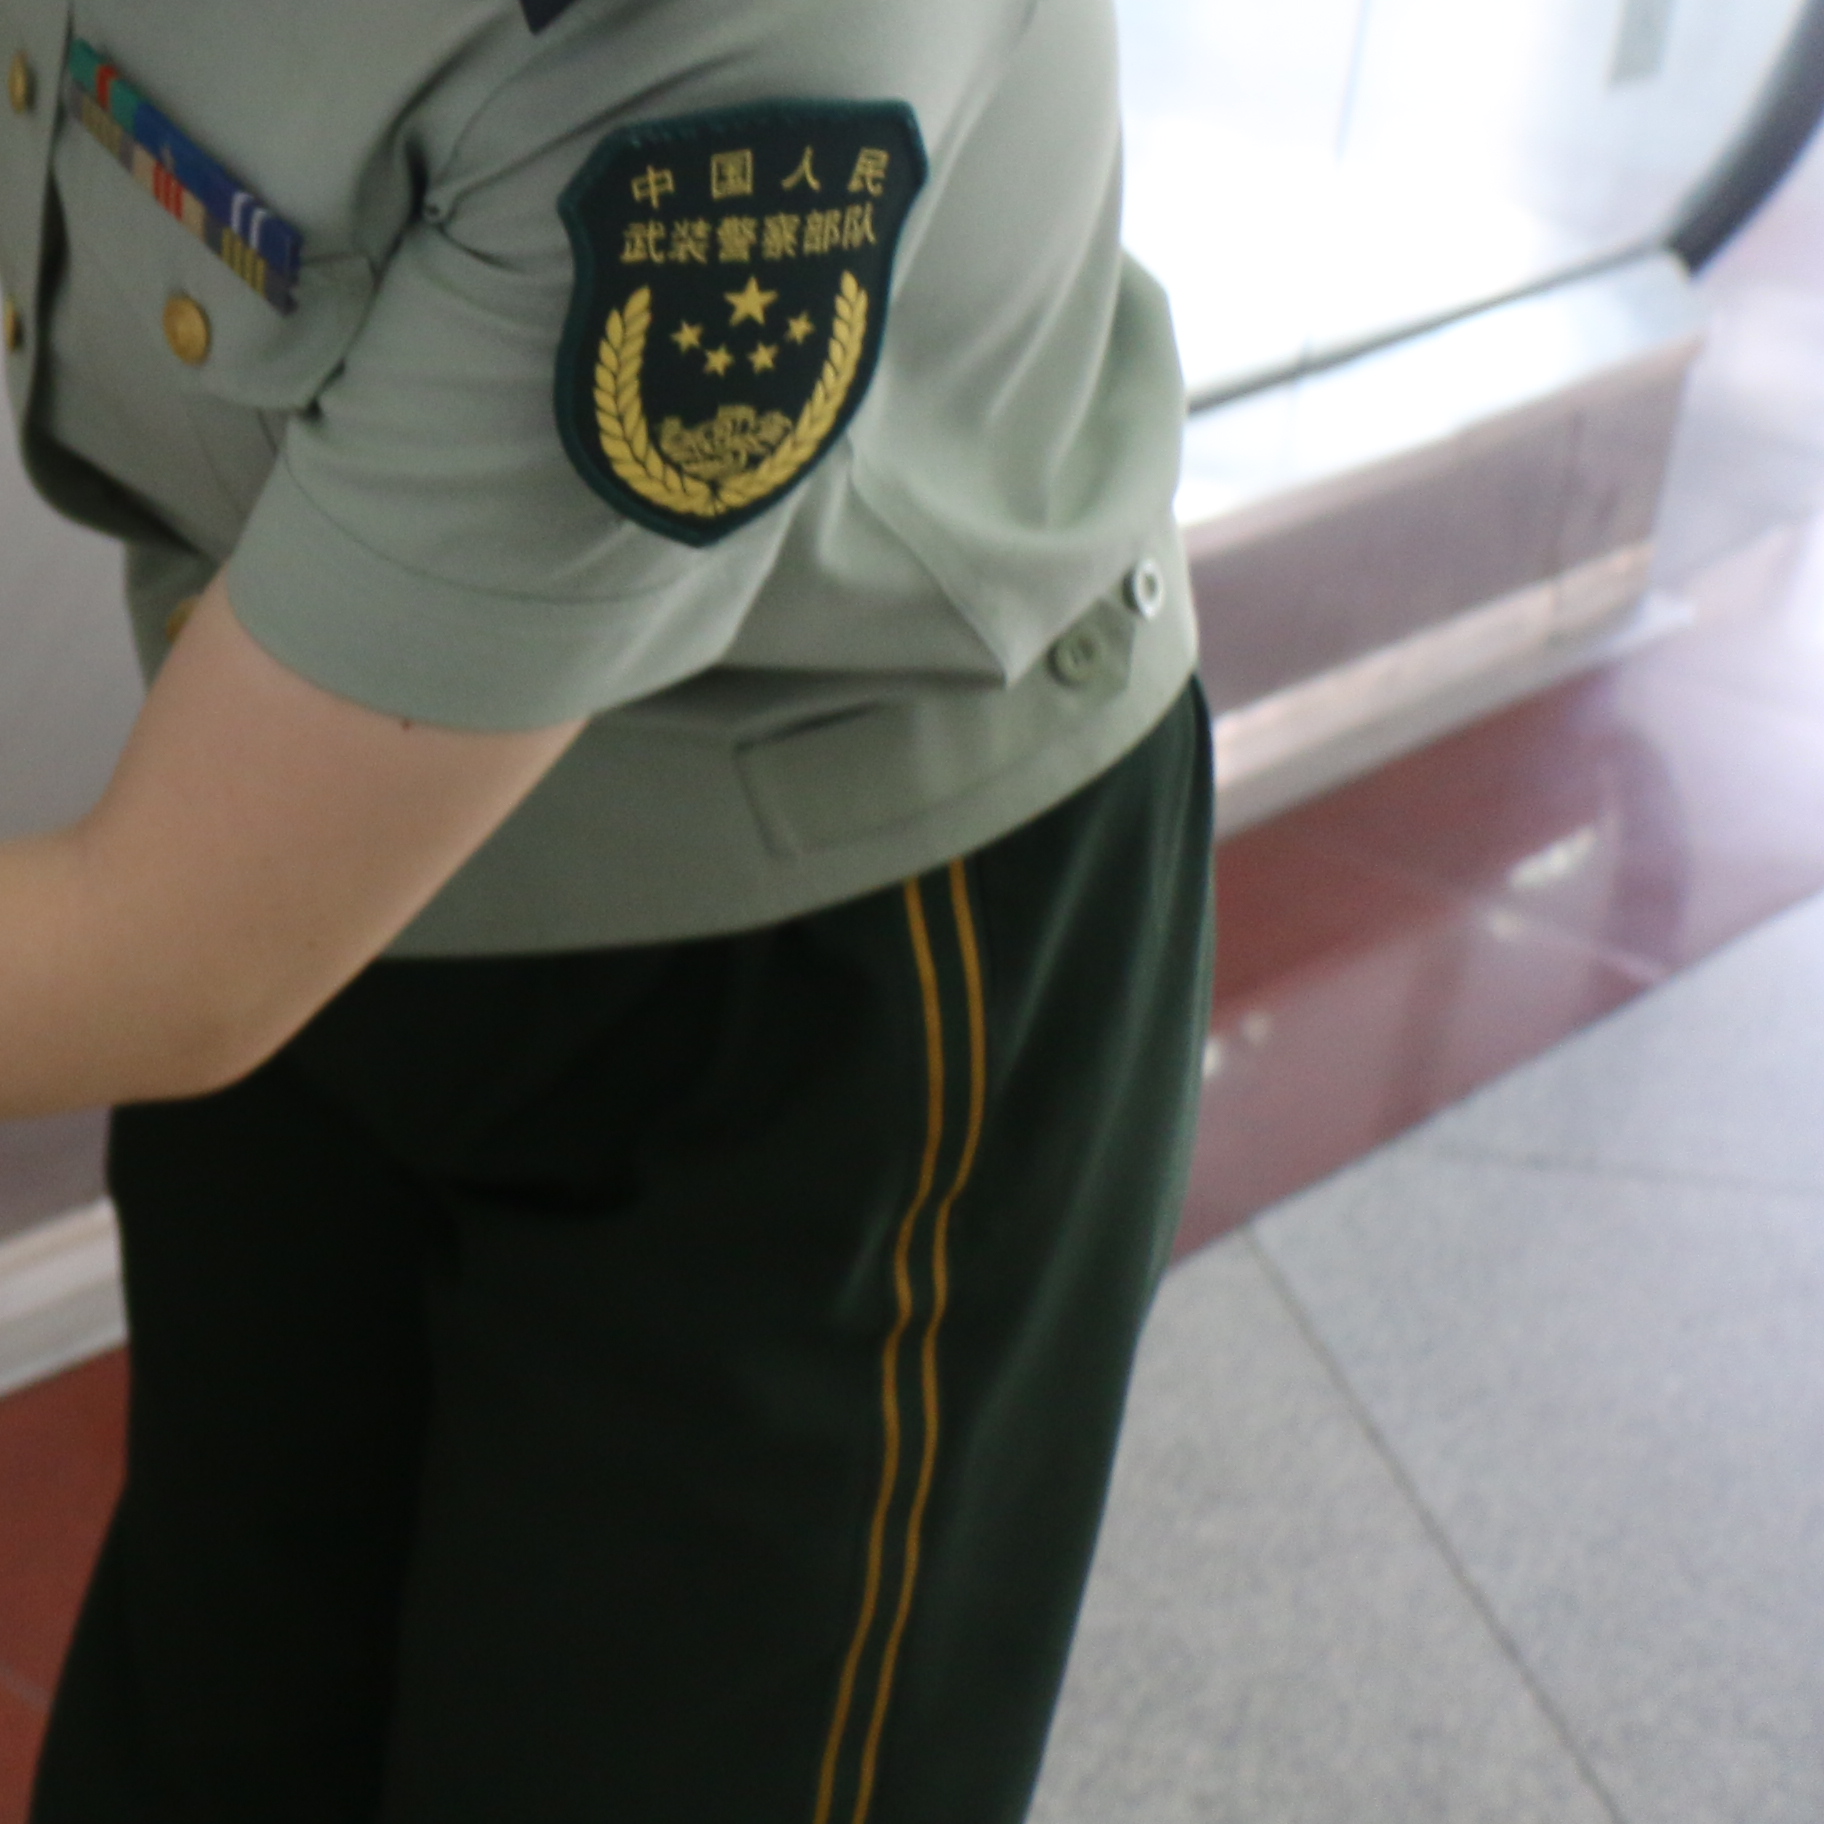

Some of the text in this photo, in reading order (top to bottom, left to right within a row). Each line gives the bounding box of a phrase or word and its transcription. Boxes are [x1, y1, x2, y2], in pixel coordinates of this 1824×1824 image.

[631, 145, 890, 209] 中国人民
[620, 202, 876, 265] 武装警察部队
